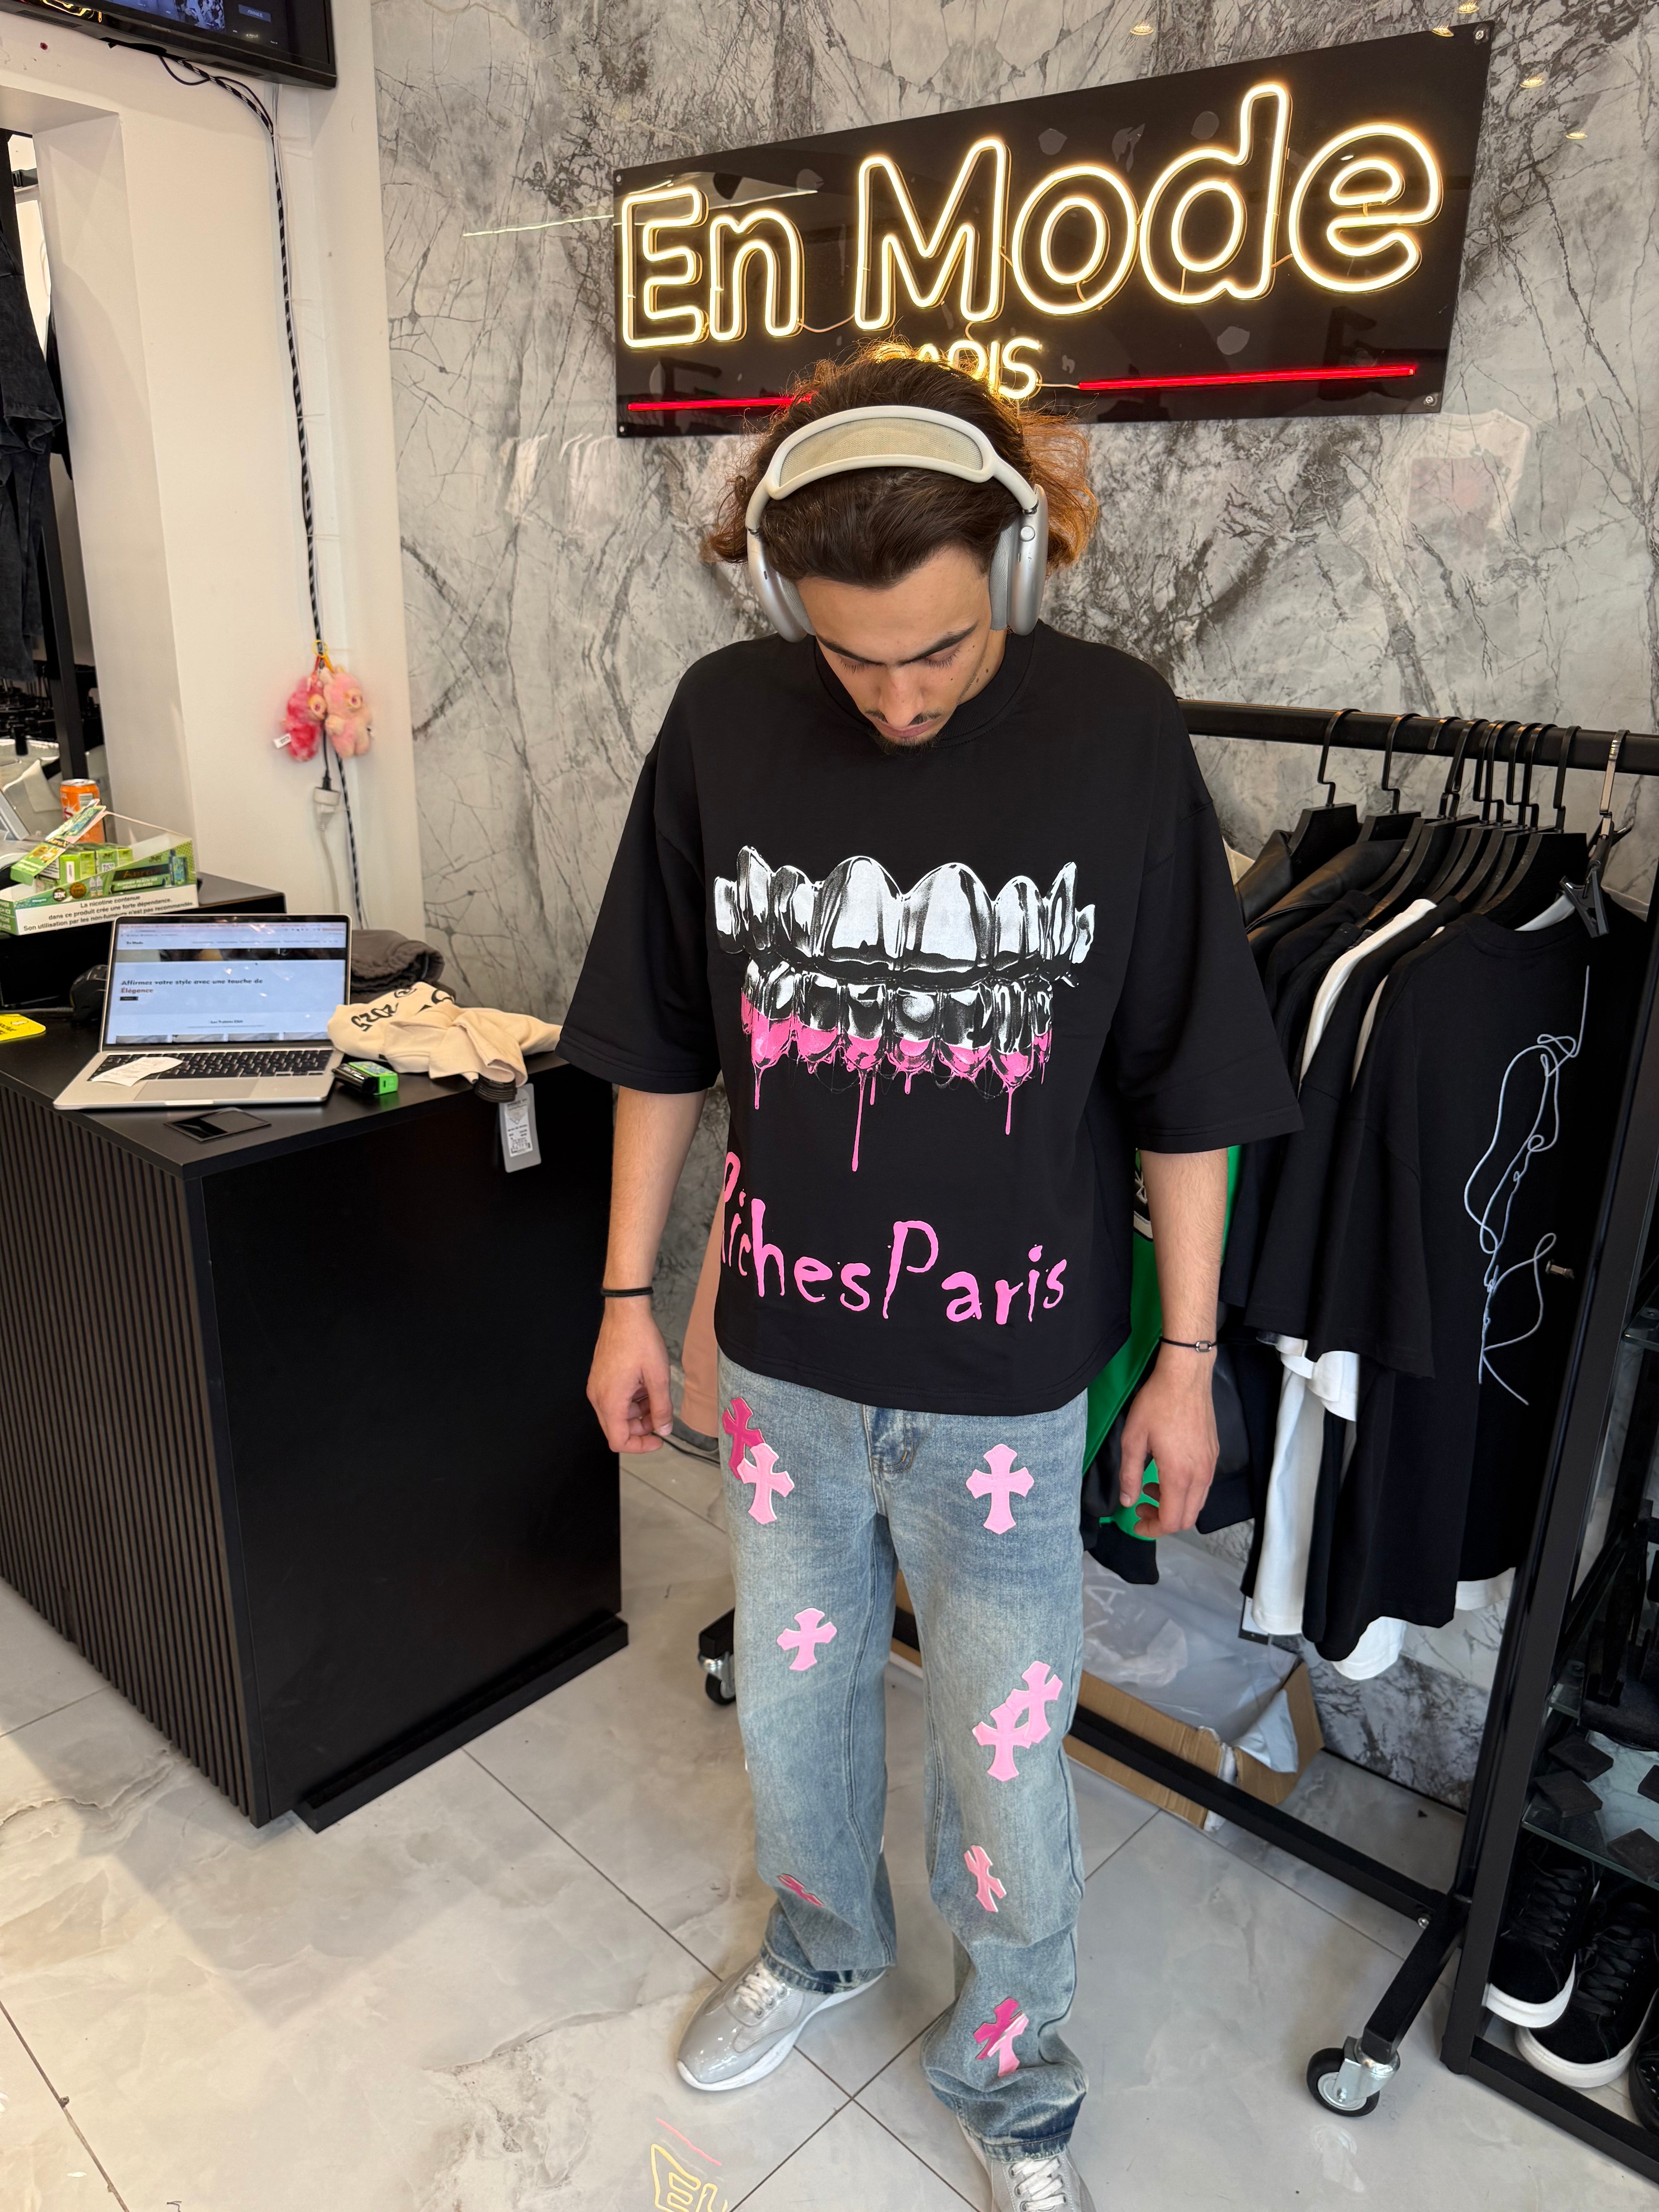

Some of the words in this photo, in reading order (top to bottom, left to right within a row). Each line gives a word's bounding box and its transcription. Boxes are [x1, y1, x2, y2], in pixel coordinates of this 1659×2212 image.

[621, 185, 804, 348] En
[854, 82, 1441, 331] Mode
[89, 899, 113, 907] nicotine
[114, 895, 140, 903] contenue
[74, 908, 95, 917] produit
[38, 919, 68, 929] utilisation
